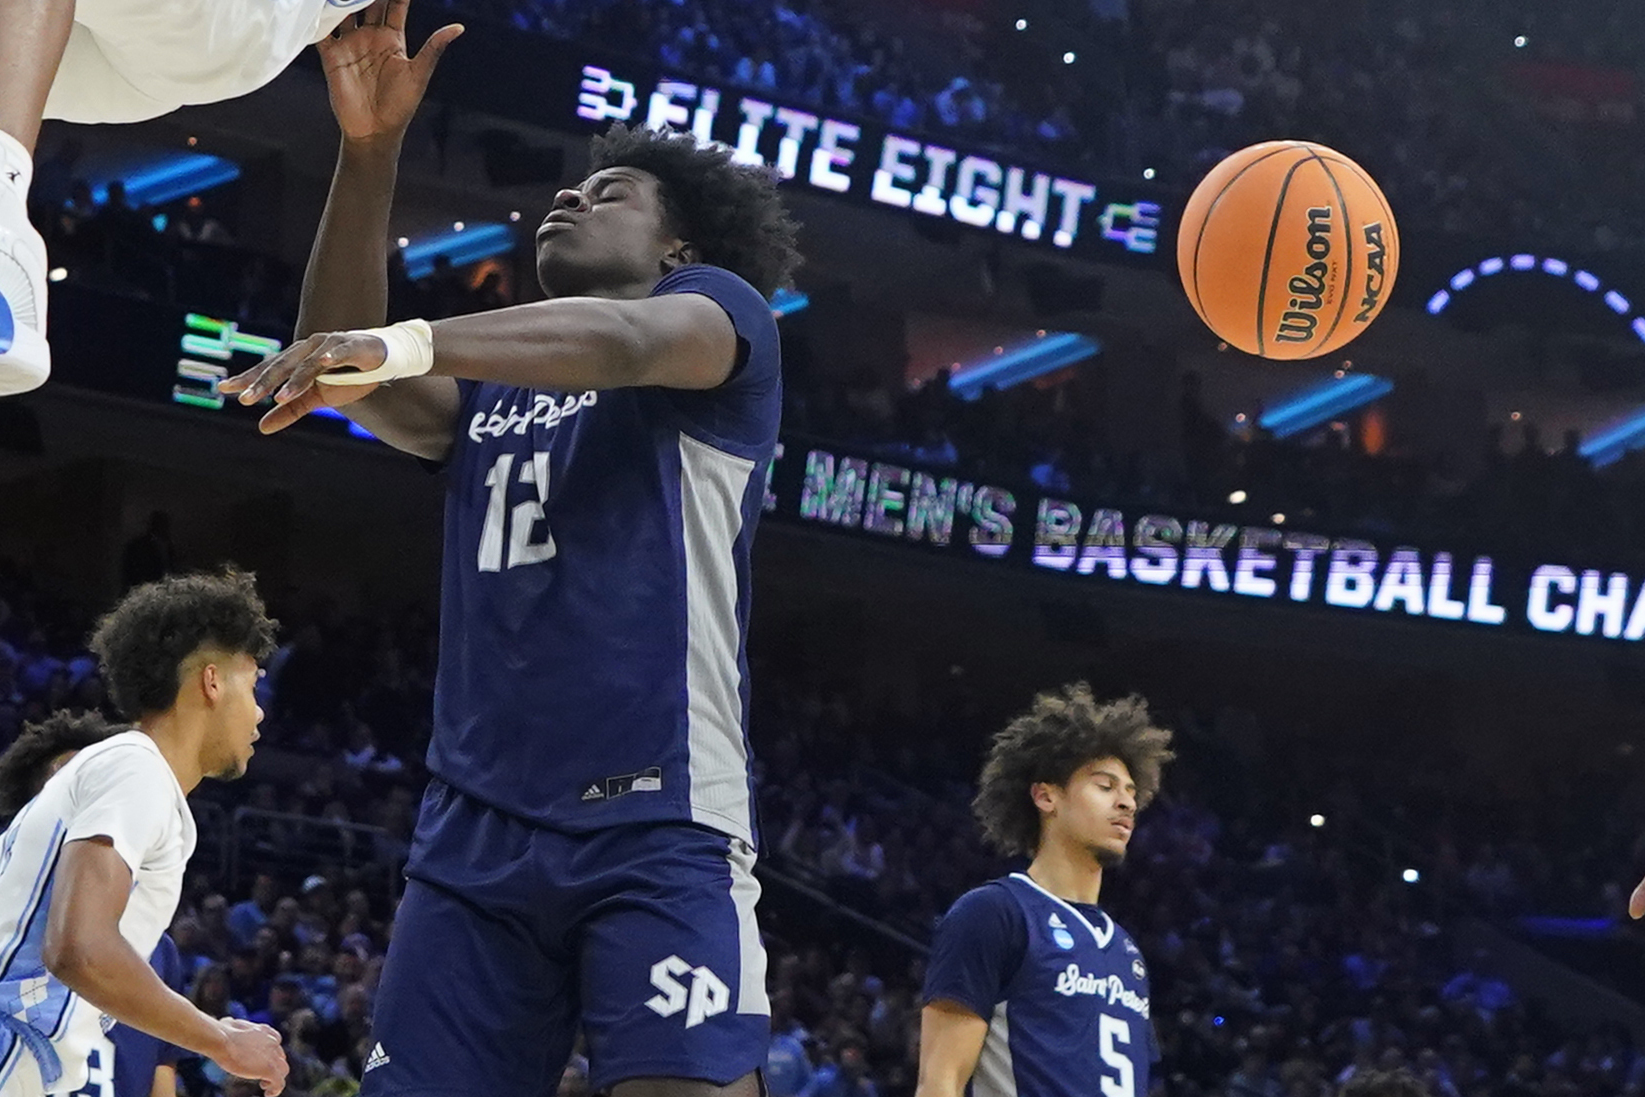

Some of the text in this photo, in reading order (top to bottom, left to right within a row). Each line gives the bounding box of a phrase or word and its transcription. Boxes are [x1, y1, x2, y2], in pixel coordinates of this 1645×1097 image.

[647, 79, 1096, 248] ELITE EIGHT
[1273, 206, 1332, 343] Wilson
[1353, 221, 1386, 323] NCAA
[478, 451, 557, 572] 12
[800, 451, 1016, 558] MEN'S
[1032, 497, 1507, 625] BASKETBALL
[1054, 963, 1108, 998] Saint
[1099, 1013, 1135, 1097] 5
